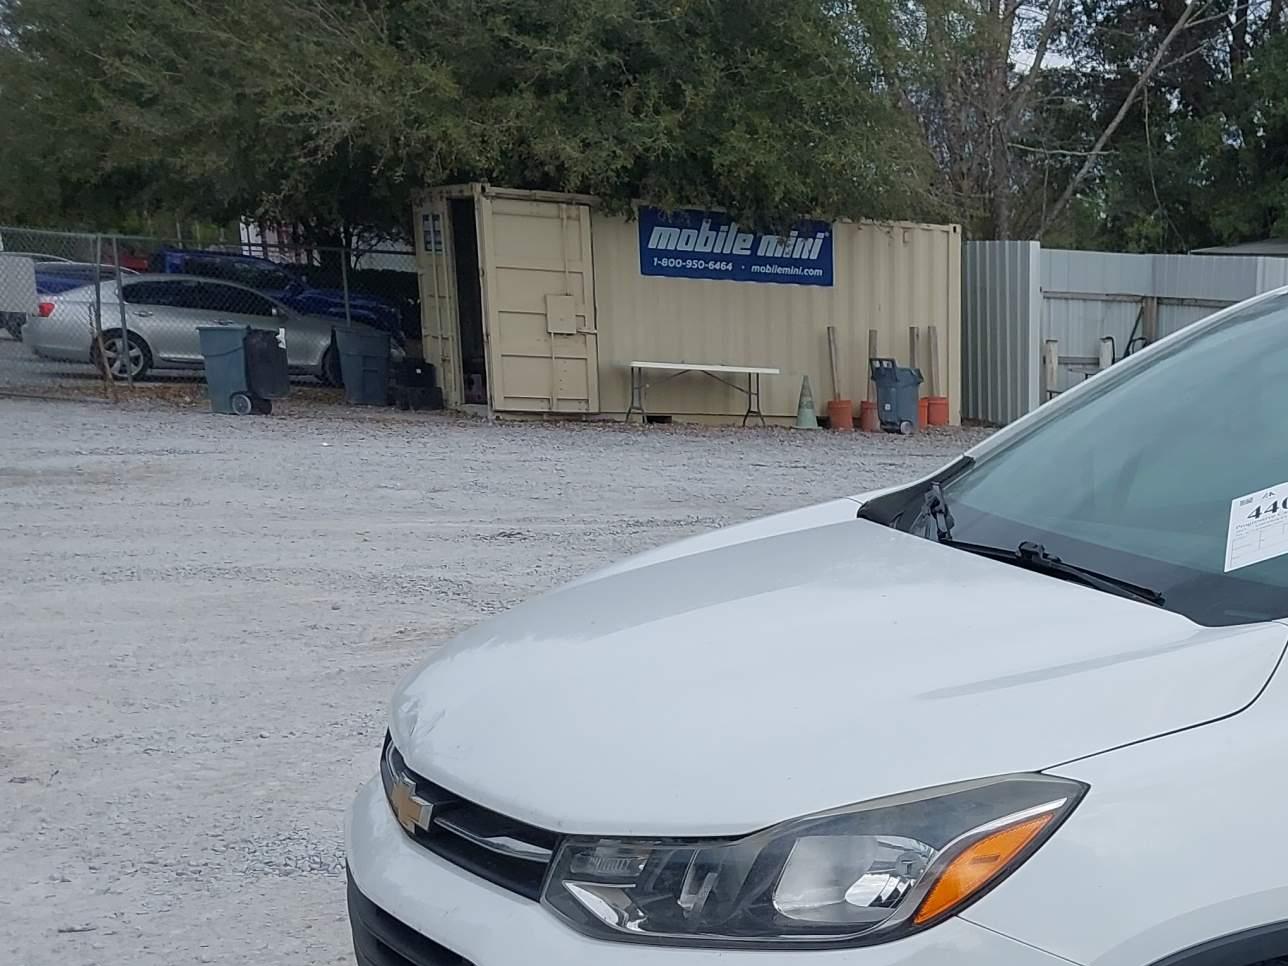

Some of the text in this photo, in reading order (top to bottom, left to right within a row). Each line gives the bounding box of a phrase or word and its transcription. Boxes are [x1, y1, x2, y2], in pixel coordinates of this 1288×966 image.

[648, 219, 825, 260] mobile mini
[653, 257, 823, 277] 1-800-950-6464 mobilemini.com
